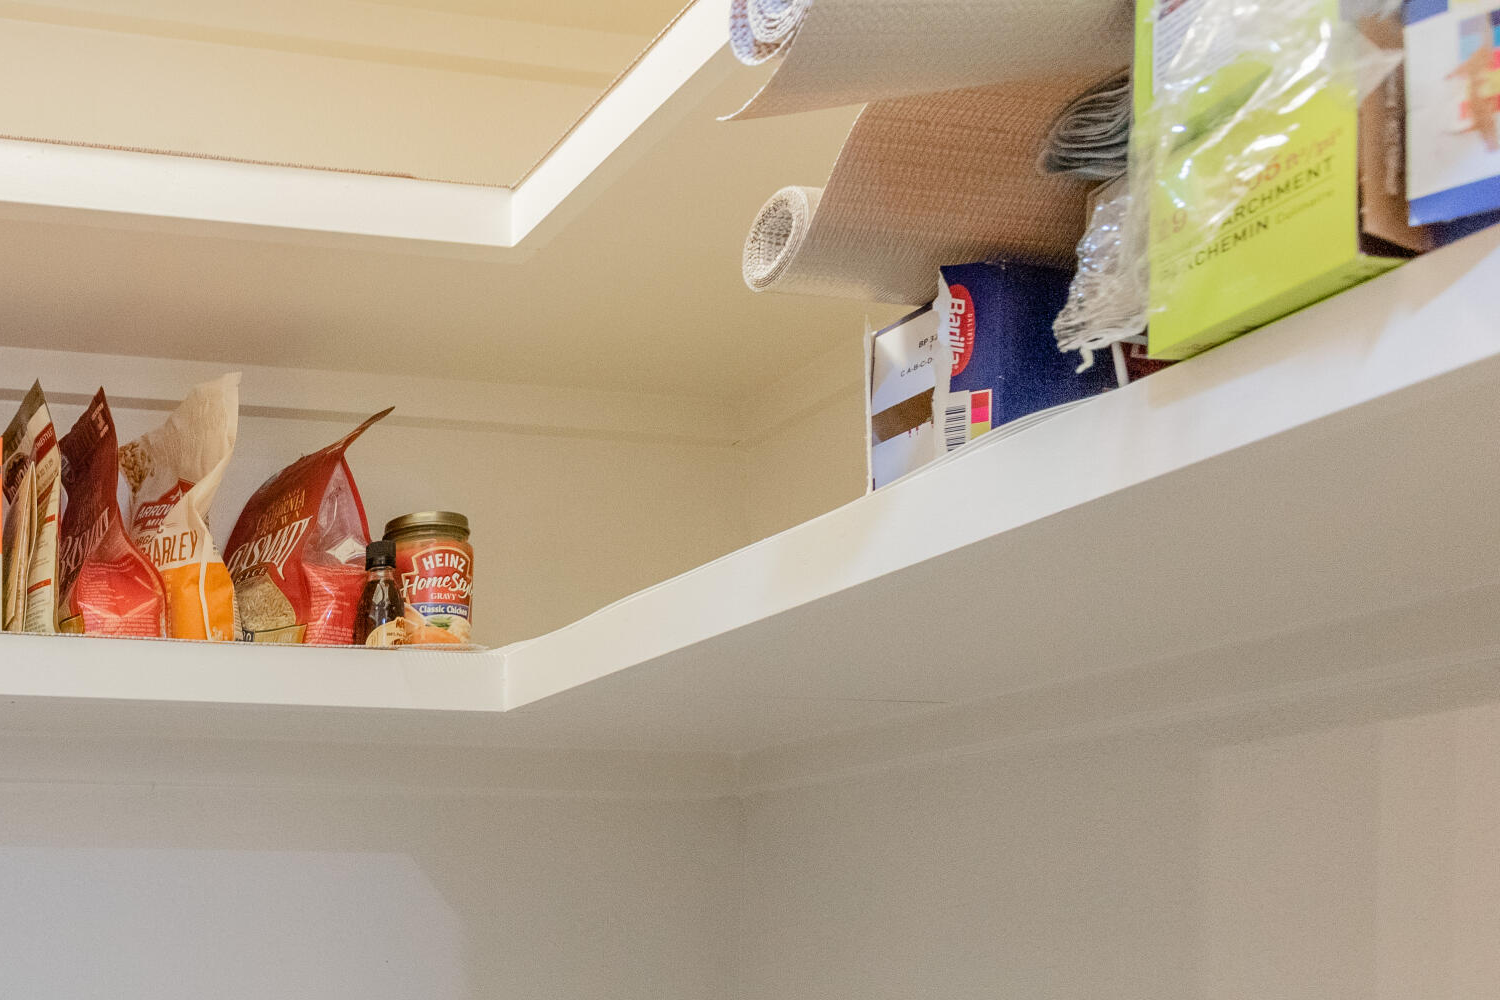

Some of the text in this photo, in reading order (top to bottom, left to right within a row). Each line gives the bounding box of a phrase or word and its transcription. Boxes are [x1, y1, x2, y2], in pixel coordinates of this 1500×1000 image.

[422, 553, 467, 572] HEINZ
[431, 592, 457, 600] GRAVY
[419, 605, 468, 616] Classic Chicken
